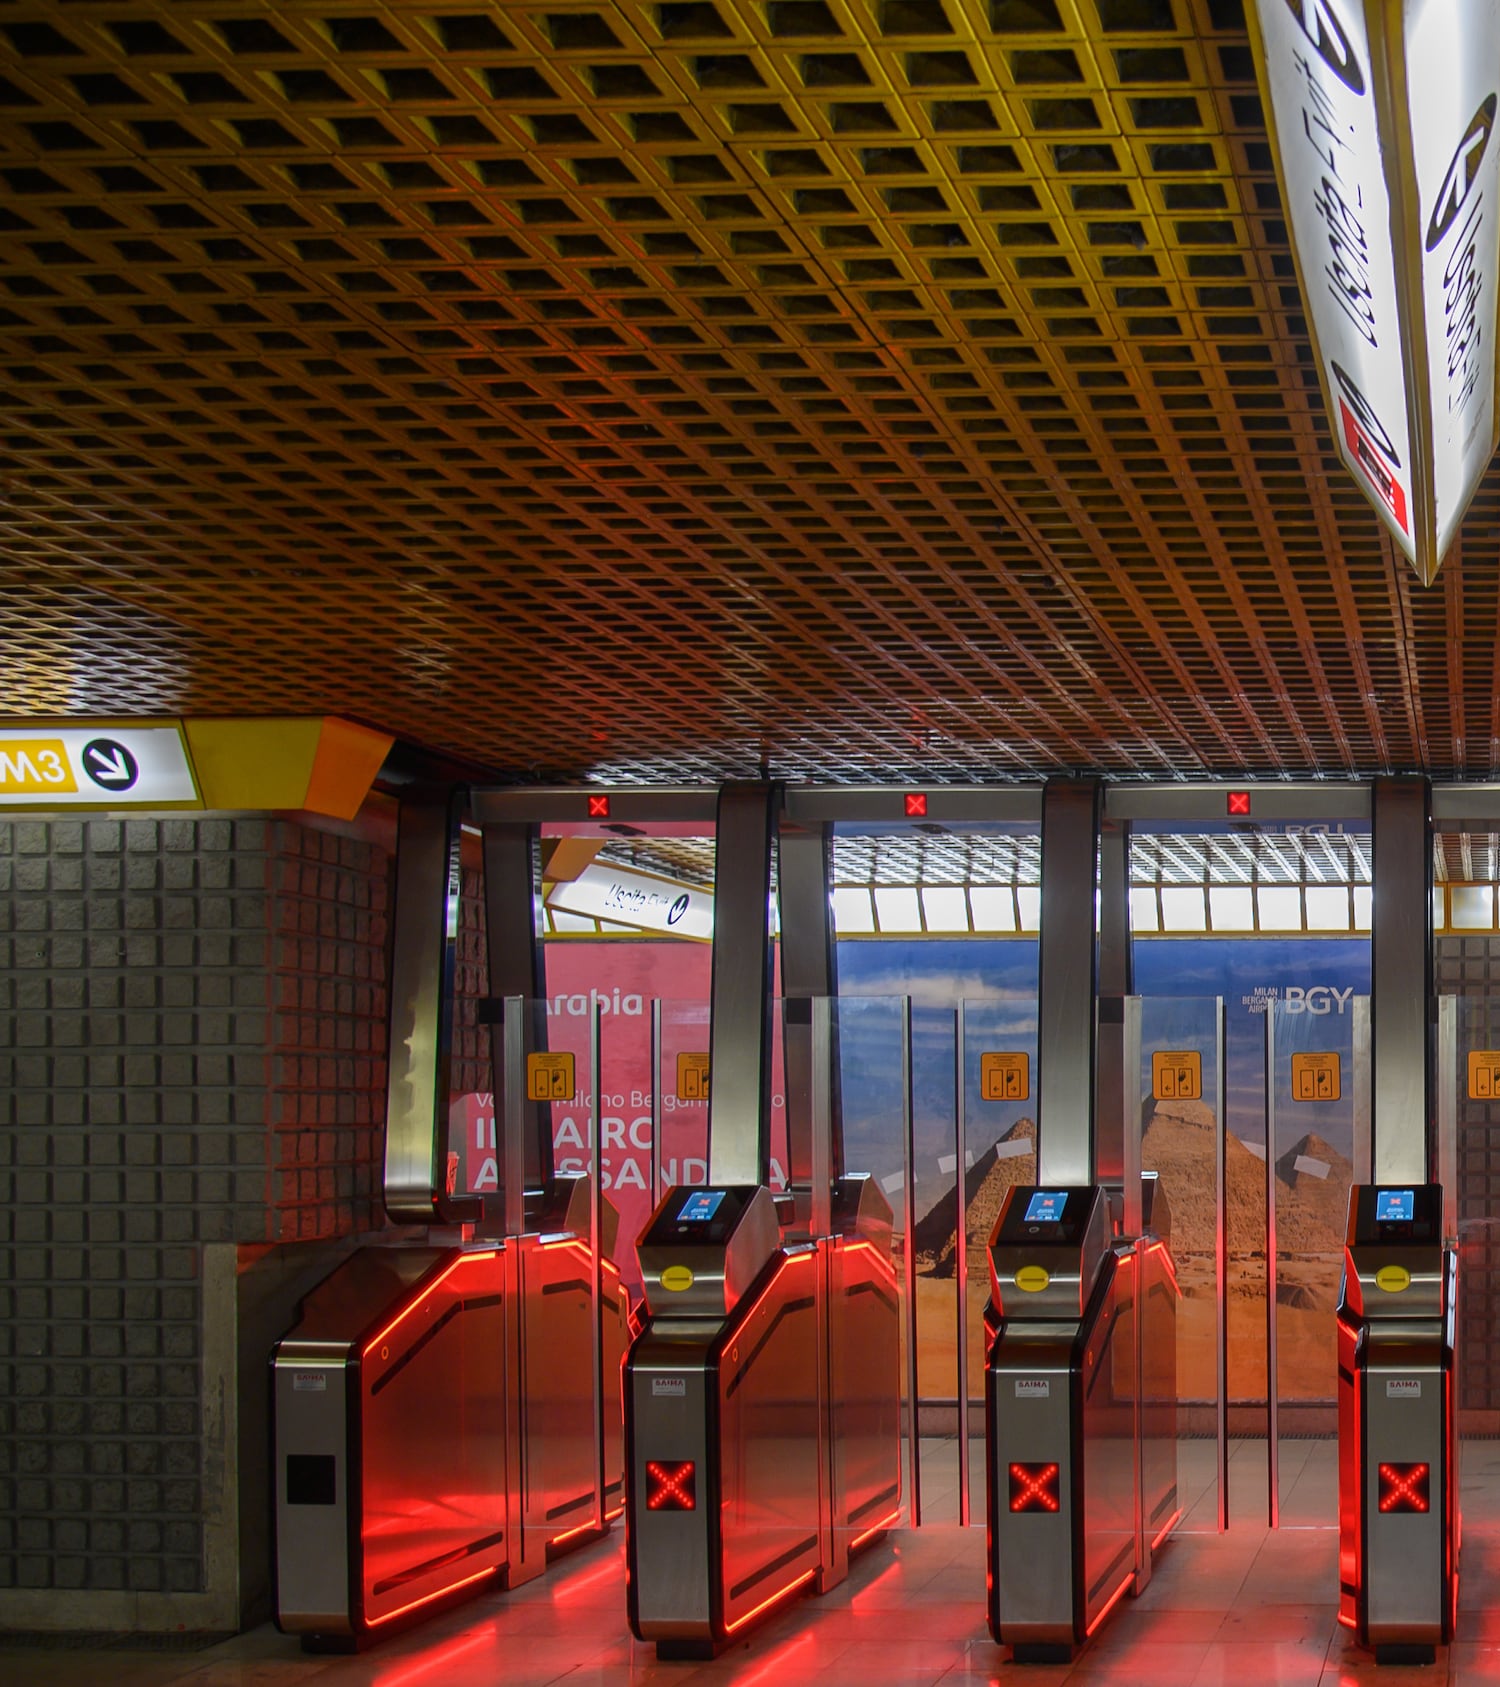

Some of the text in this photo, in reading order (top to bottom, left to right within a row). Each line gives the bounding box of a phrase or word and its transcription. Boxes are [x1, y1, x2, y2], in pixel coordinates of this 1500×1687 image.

[1314, 176, 1378, 348] Uscita
[1443, 191, 1483, 379] Uscita
[0, 750, 66, 783] M3
[1242, 996, 1278, 1005] BERGAO
[1254, 987, 1278, 996] MILAN
[1286, 987, 1353, 1015] BGY
[631, 1091, 709, 1112] Begam
[553, 1117, 653, 1150] AIRO
